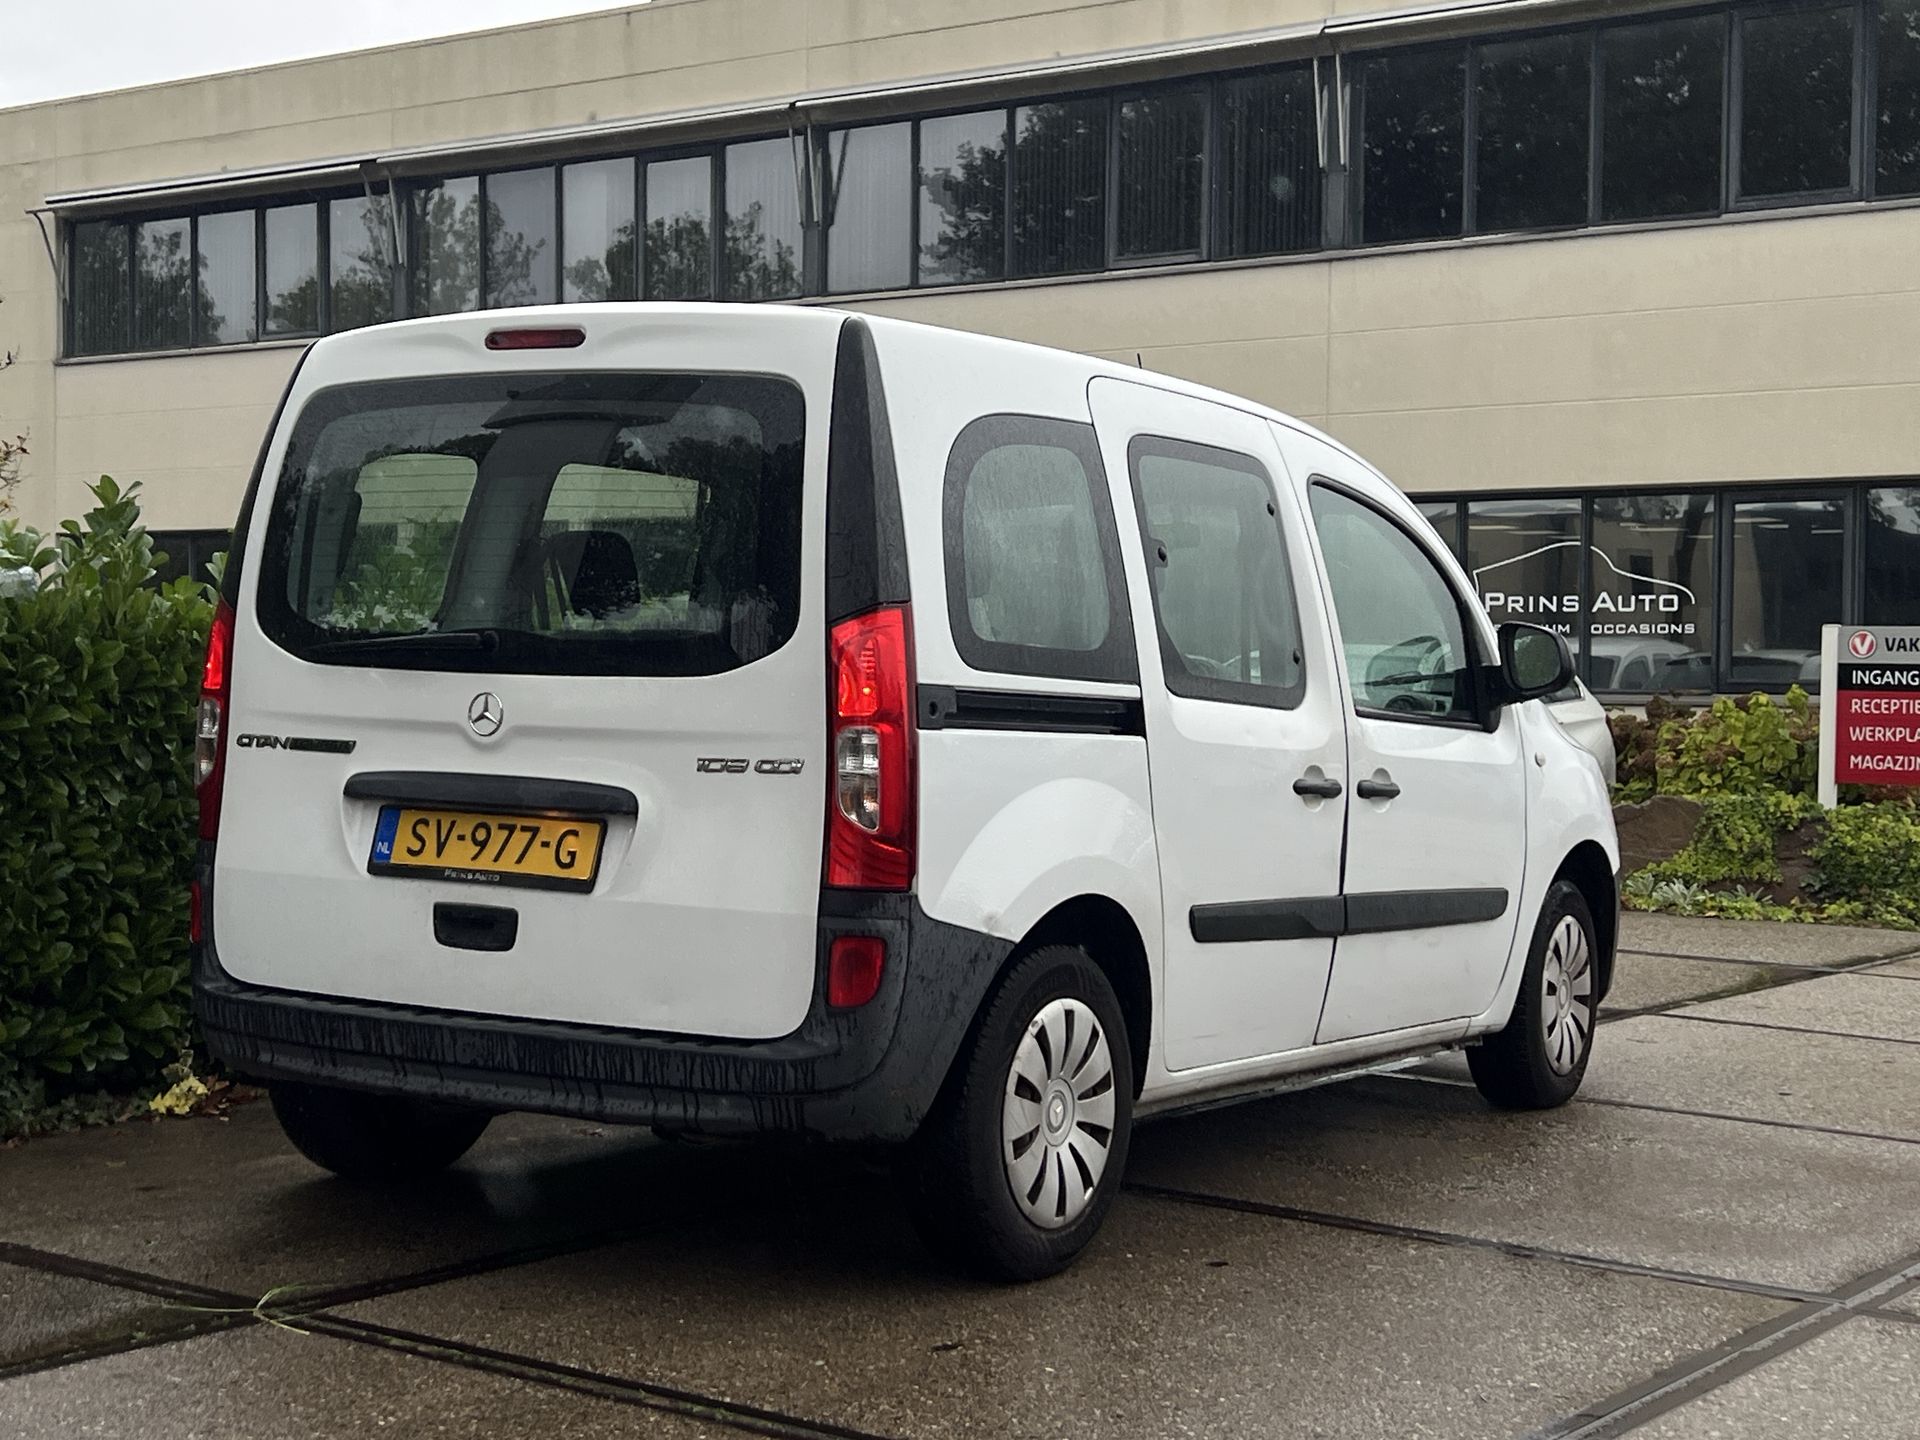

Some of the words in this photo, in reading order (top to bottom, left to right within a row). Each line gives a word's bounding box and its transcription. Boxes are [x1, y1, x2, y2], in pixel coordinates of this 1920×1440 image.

[1592, 591, 1680, 612] AUTO
[1590, 623, 1696, 634] OCCASIONS
[1884, 637, 1920, 652] VAK
[1851, 669, 1920, 686] INGANG
[1851, 699, 1920, 714] RECEPTIE
[376, 840, 391, 854] NL
[406, 817, 580, 870] SV-977-G
